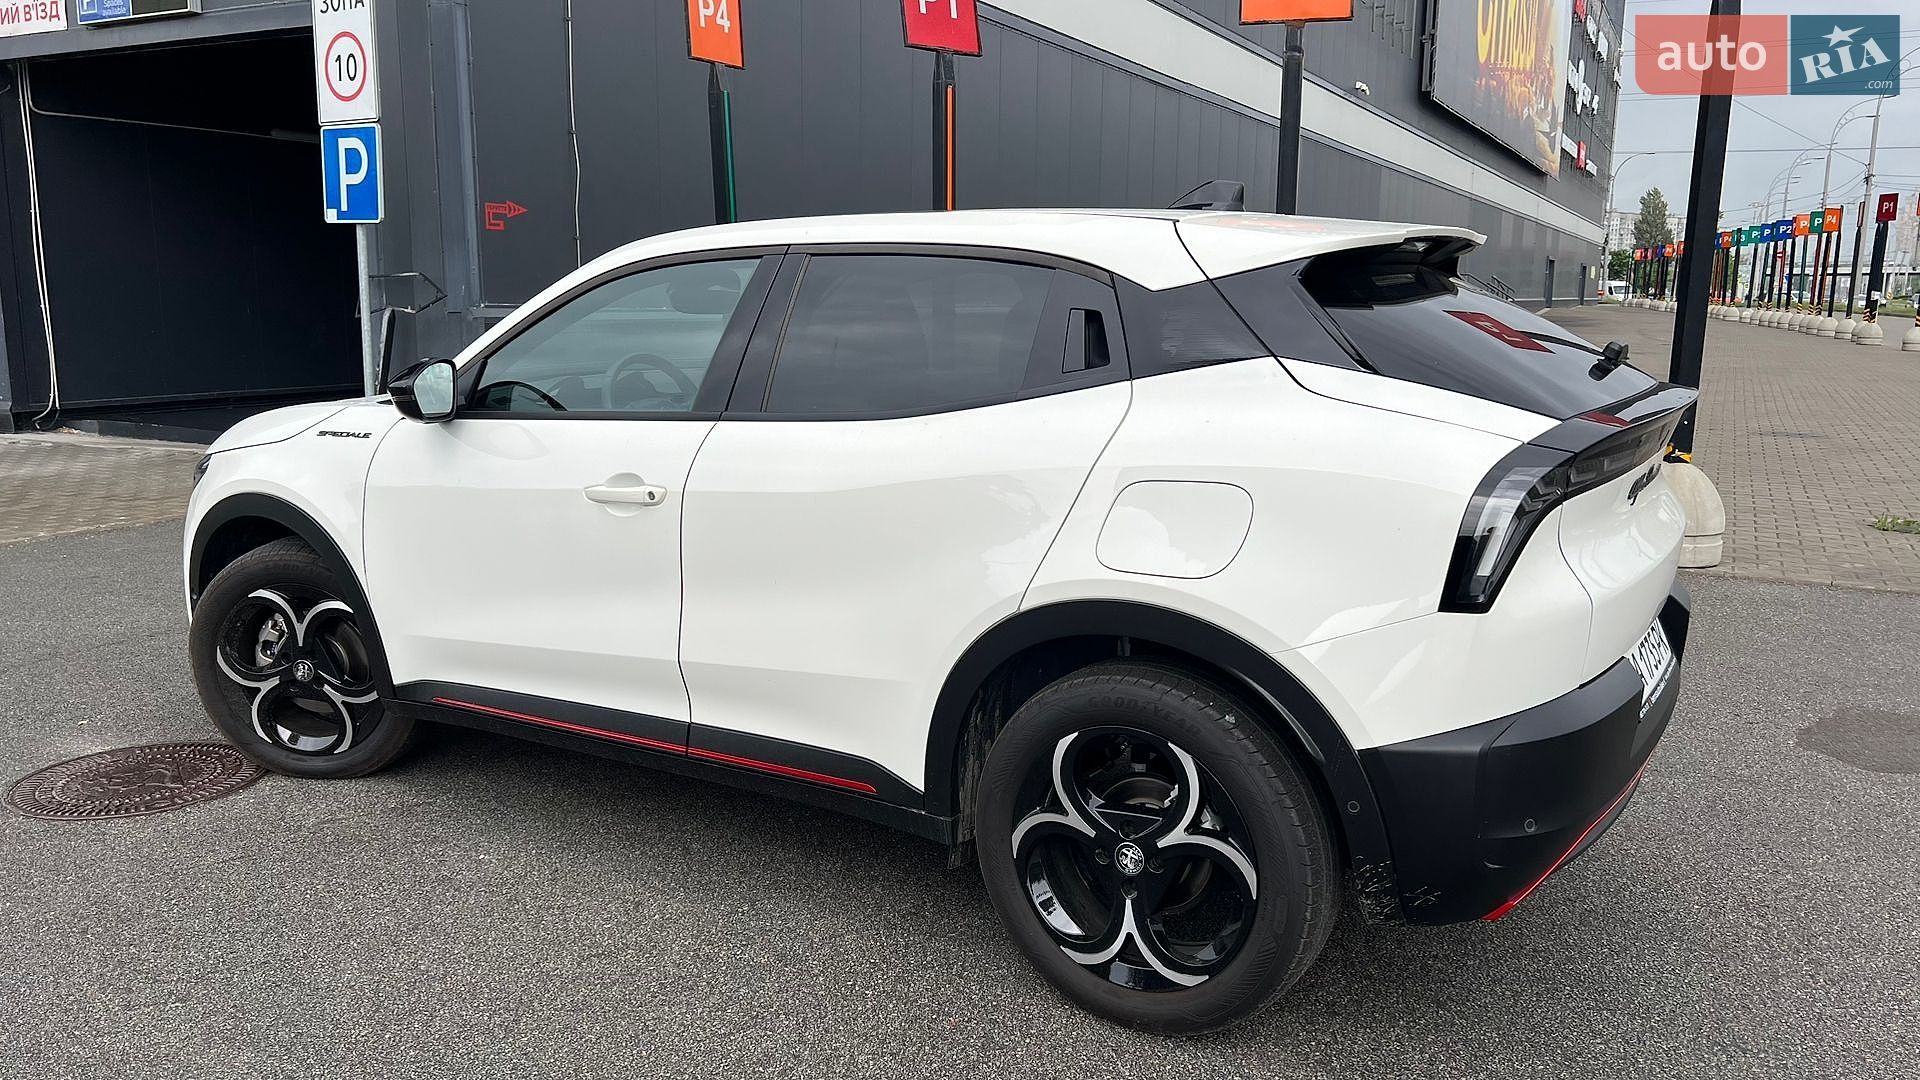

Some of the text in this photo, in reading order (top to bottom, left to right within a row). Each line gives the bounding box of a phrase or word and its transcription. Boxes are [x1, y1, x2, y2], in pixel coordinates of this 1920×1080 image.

[698, 0, 731, 34] P4
[335, 53, 357, 82] 10
[338, 137, 369, 212] P
[1883, 201, 1894, 214] P1
[1826, 214, 1837, 224] P4
[1779, 225, 1792, 235] P2
[317, 430, 372, 438] SPECIALE
